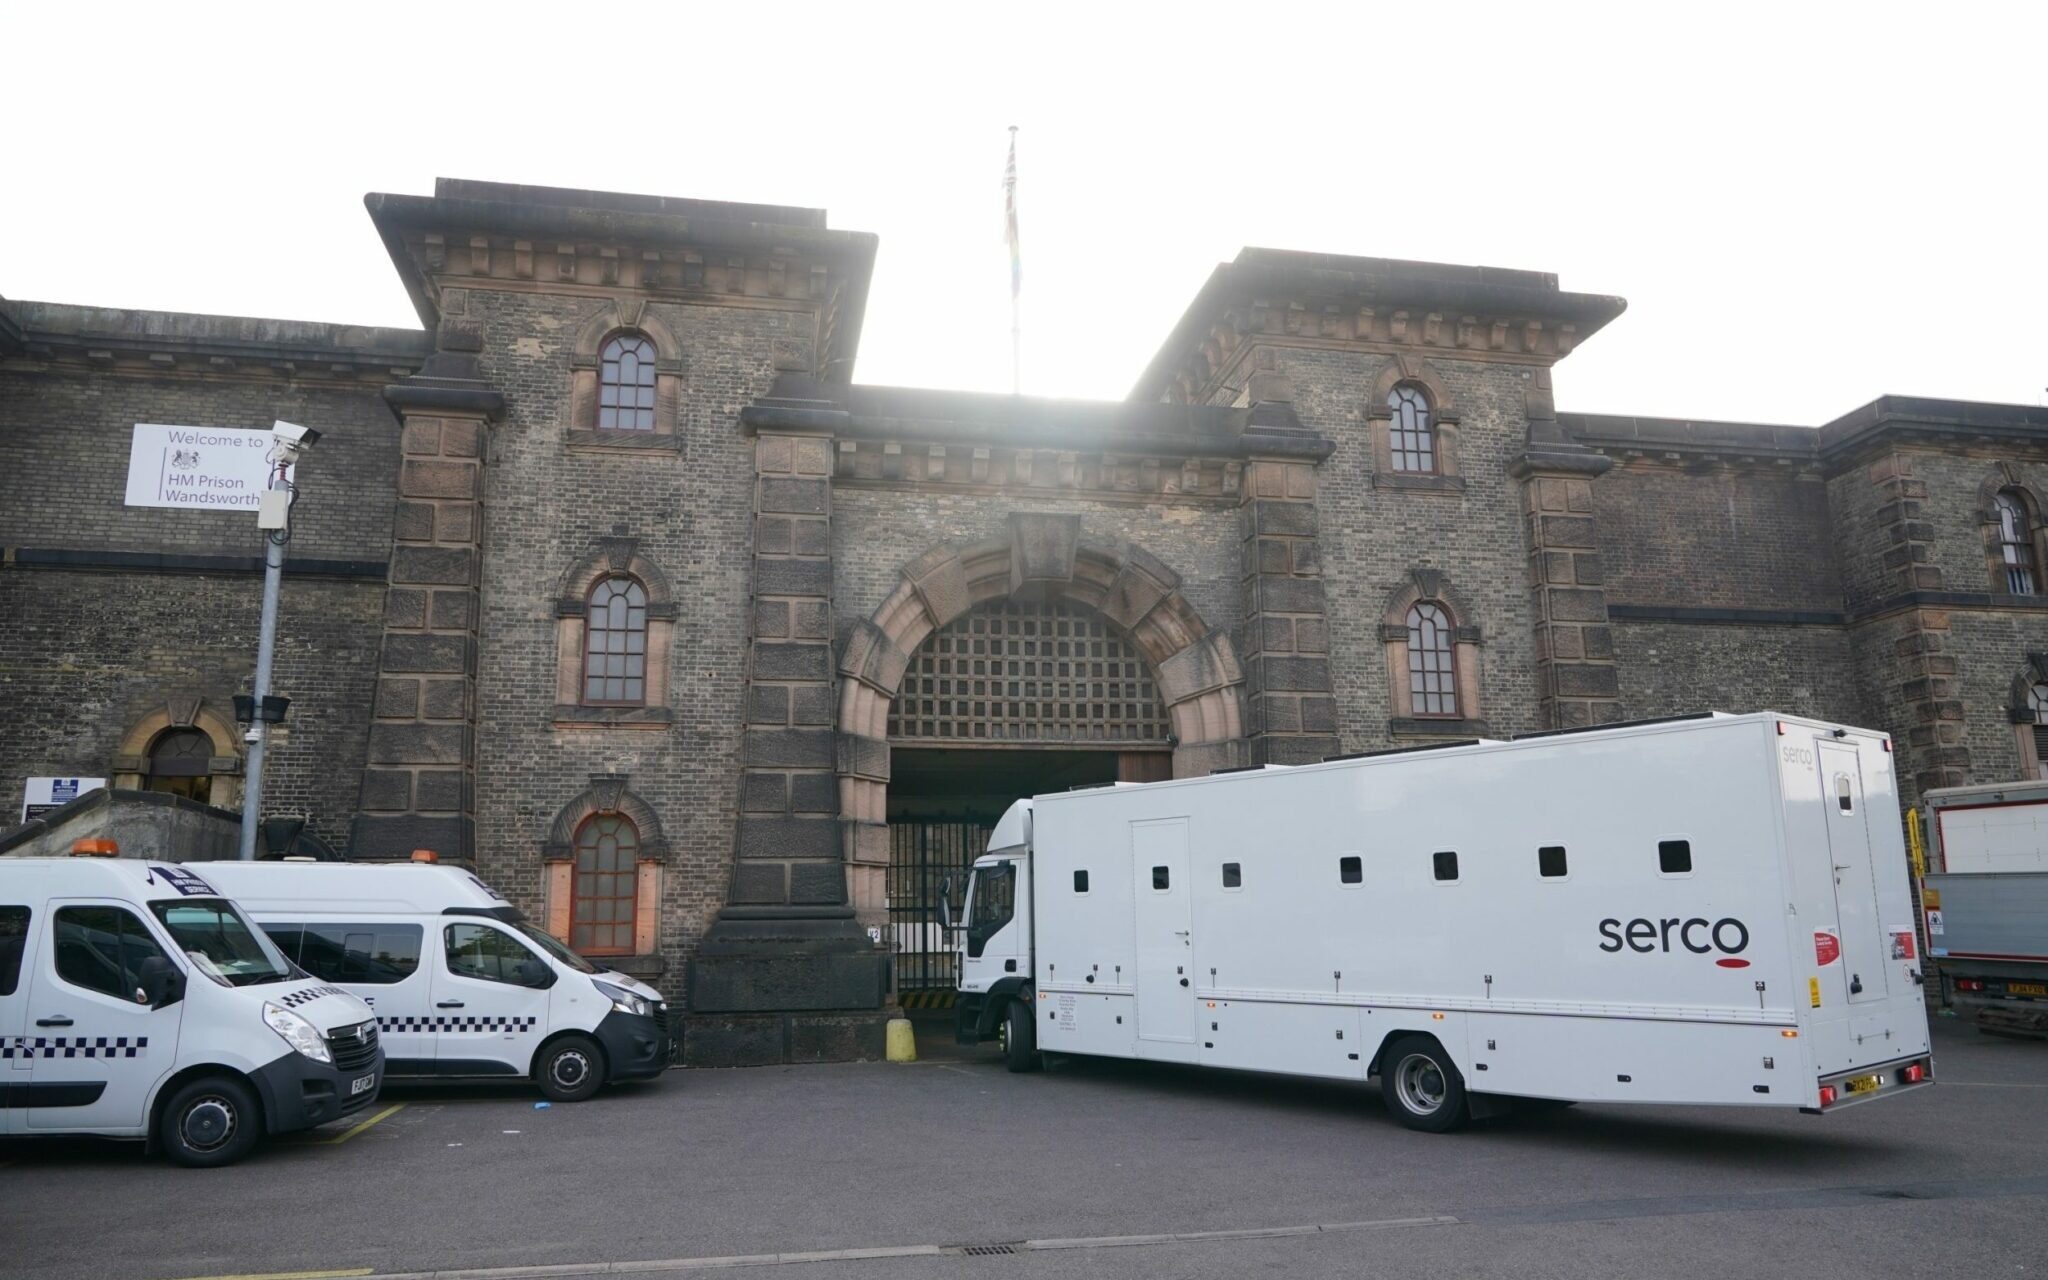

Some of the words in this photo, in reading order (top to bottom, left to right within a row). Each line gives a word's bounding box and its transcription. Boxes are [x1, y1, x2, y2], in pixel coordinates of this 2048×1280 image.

[168, 431, 242, 447] Welcome
[248, 435, 263, 448] to
[168, 474, 194, 487] HM
[199, 474, 244, 489] Prison
[165, 489, 260, 505] Wandsworth
[1782, 745, 1812, 765] serco
[1598, 917, 1750, 955] serco
